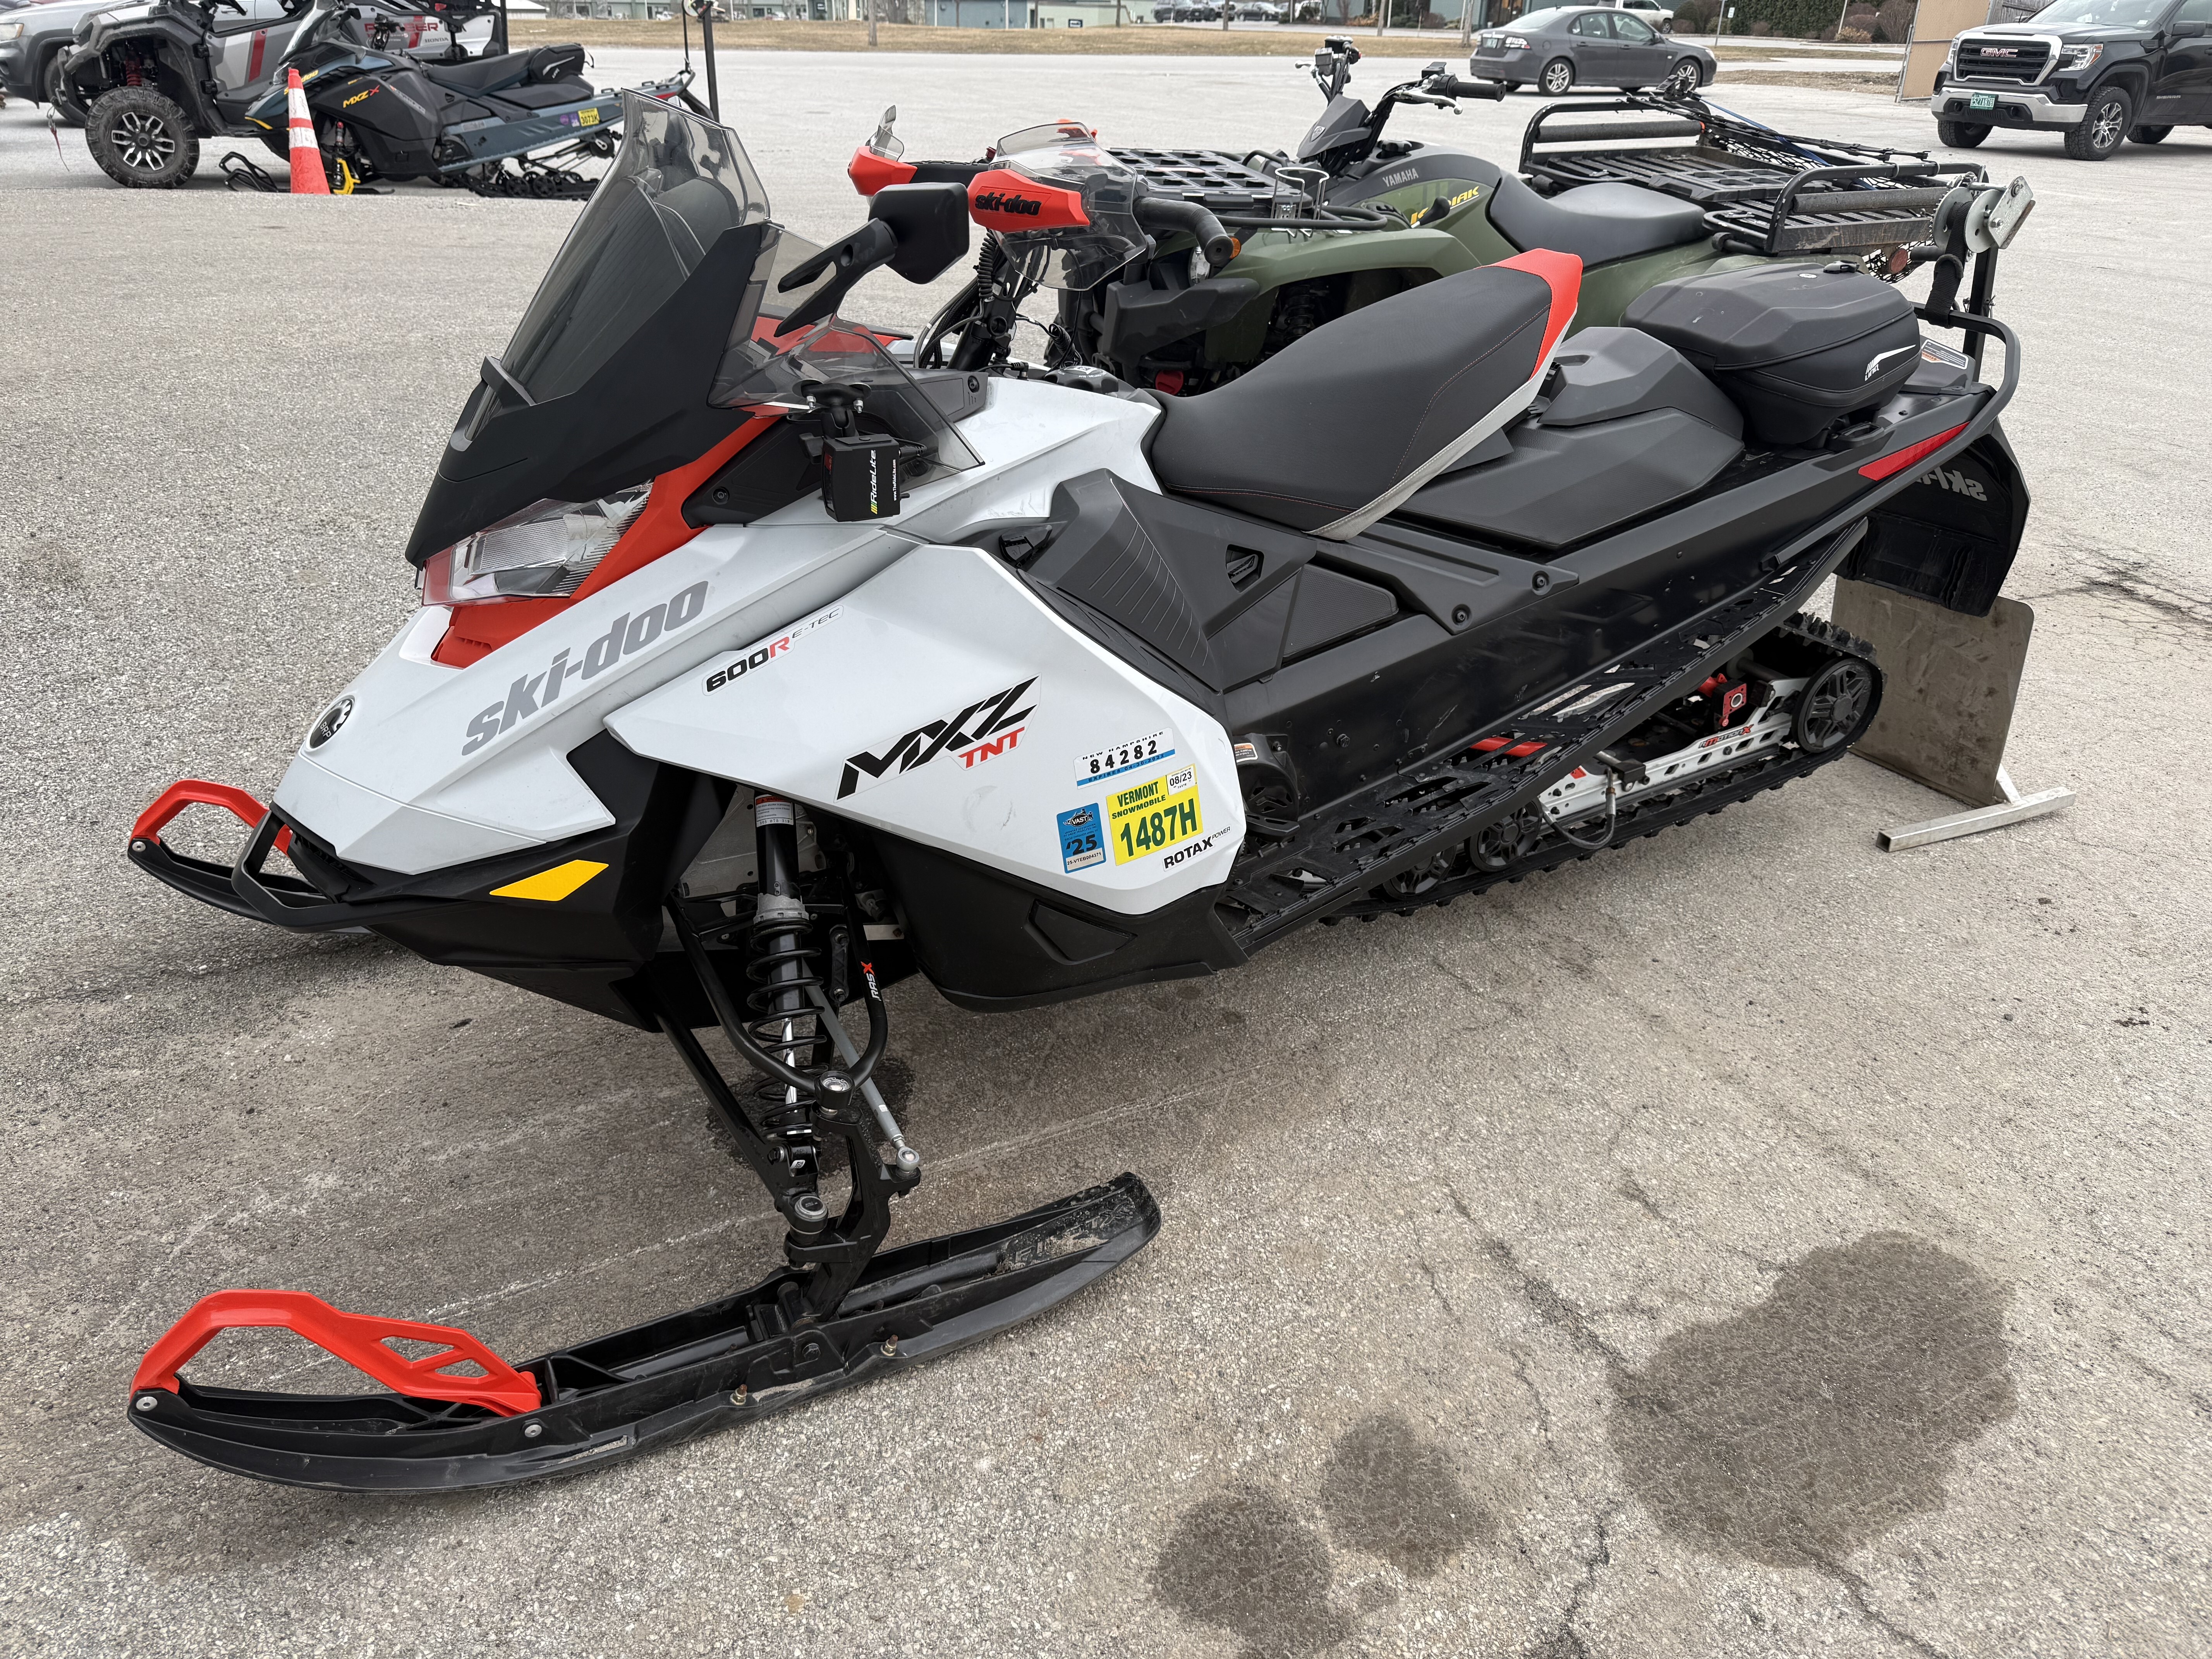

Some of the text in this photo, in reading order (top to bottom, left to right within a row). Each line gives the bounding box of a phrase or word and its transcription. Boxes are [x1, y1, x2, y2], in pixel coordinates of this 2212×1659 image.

[1980, 48, 2018, 58] GMC
[343, 90, 369, 108] MXZ
[1382, 168, 1419, 187] YAMAHA
[975, 192, 1042, 216] ski-doo
[1411, 186, 1479, 224] KIAK
[706, 608, 840, 692] 600R E-TEC
[462, 581, 709, 756] ski-doo
[320, 721, 331, 737] BRP
[837, 675, 1039, 800] MXZ
[958, 726, 1025, 769] TNT
[1083, 732, 1163, 760] NEW HAMPSHIRE
[1090, 740, 1157, 774] 84282
[1170, 771, 1192, 786] 08/23
[1117, 781, 1158, 807] VERMONT
[1112, 795, 1166, 819] SNOWMOBILE
[1072, 816, 1087, 824] VAST
[1120, 798, 1197, 857] 1487H
[1066, 834, 1097, 856] '25
[1164, 826, 1230, 869] ROTAX POWER
[1067, 852, 1101, 865] 25-VTEB004371
